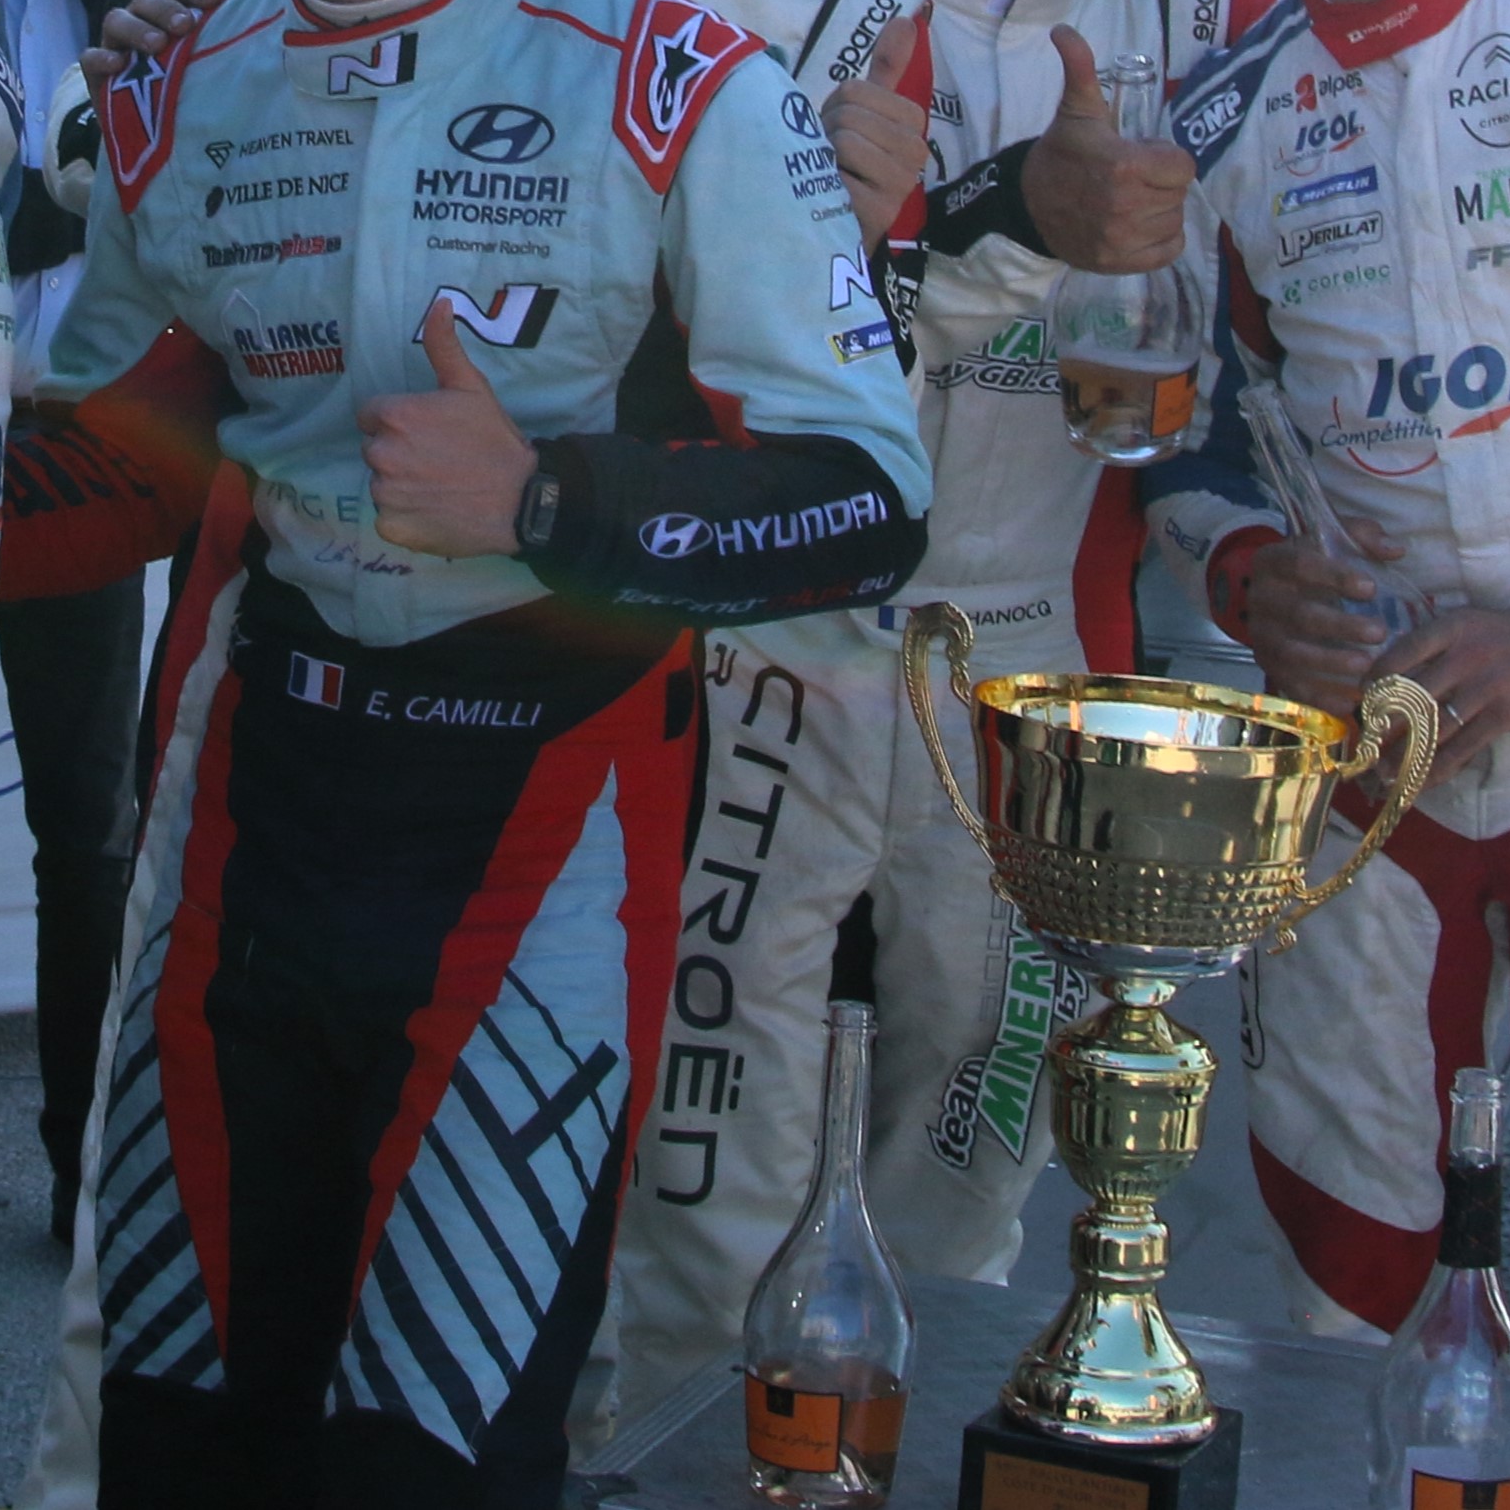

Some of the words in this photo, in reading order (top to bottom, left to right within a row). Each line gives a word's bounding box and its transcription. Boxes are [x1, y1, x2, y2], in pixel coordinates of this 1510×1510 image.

[1266, 93, 1294, 114] les
[1319, 70, 1364, 98] alpes
[1187, 92, 1242, 148] OMP
[239, 131, 291, 158] HEAVEN
[295, 128, 354, 148] TRAVEL
[225, 180, 273, 207] VILLE
[277, 177, 304, 198] DE
[308, 172, 351, 194] NICE
[415, 167, 569, 204] HYUNDAI
[413, 200, 568, 228] MOTORSPORT
[427, 235, 498, 256] Customer
[499, 239, 551, 258] Racing
[1309, 263, 1391, 293] corelec
[242, 347, 346, 379] MATERIAUX
[714, 490, 889, 556] HYUNDAI
[366, 690, 392, 720] E.
[405, 696, 542, 727] CAMILLI
[656, 664, 805, 1207] CITROËN
[927, 1056, 989, 1170] team
